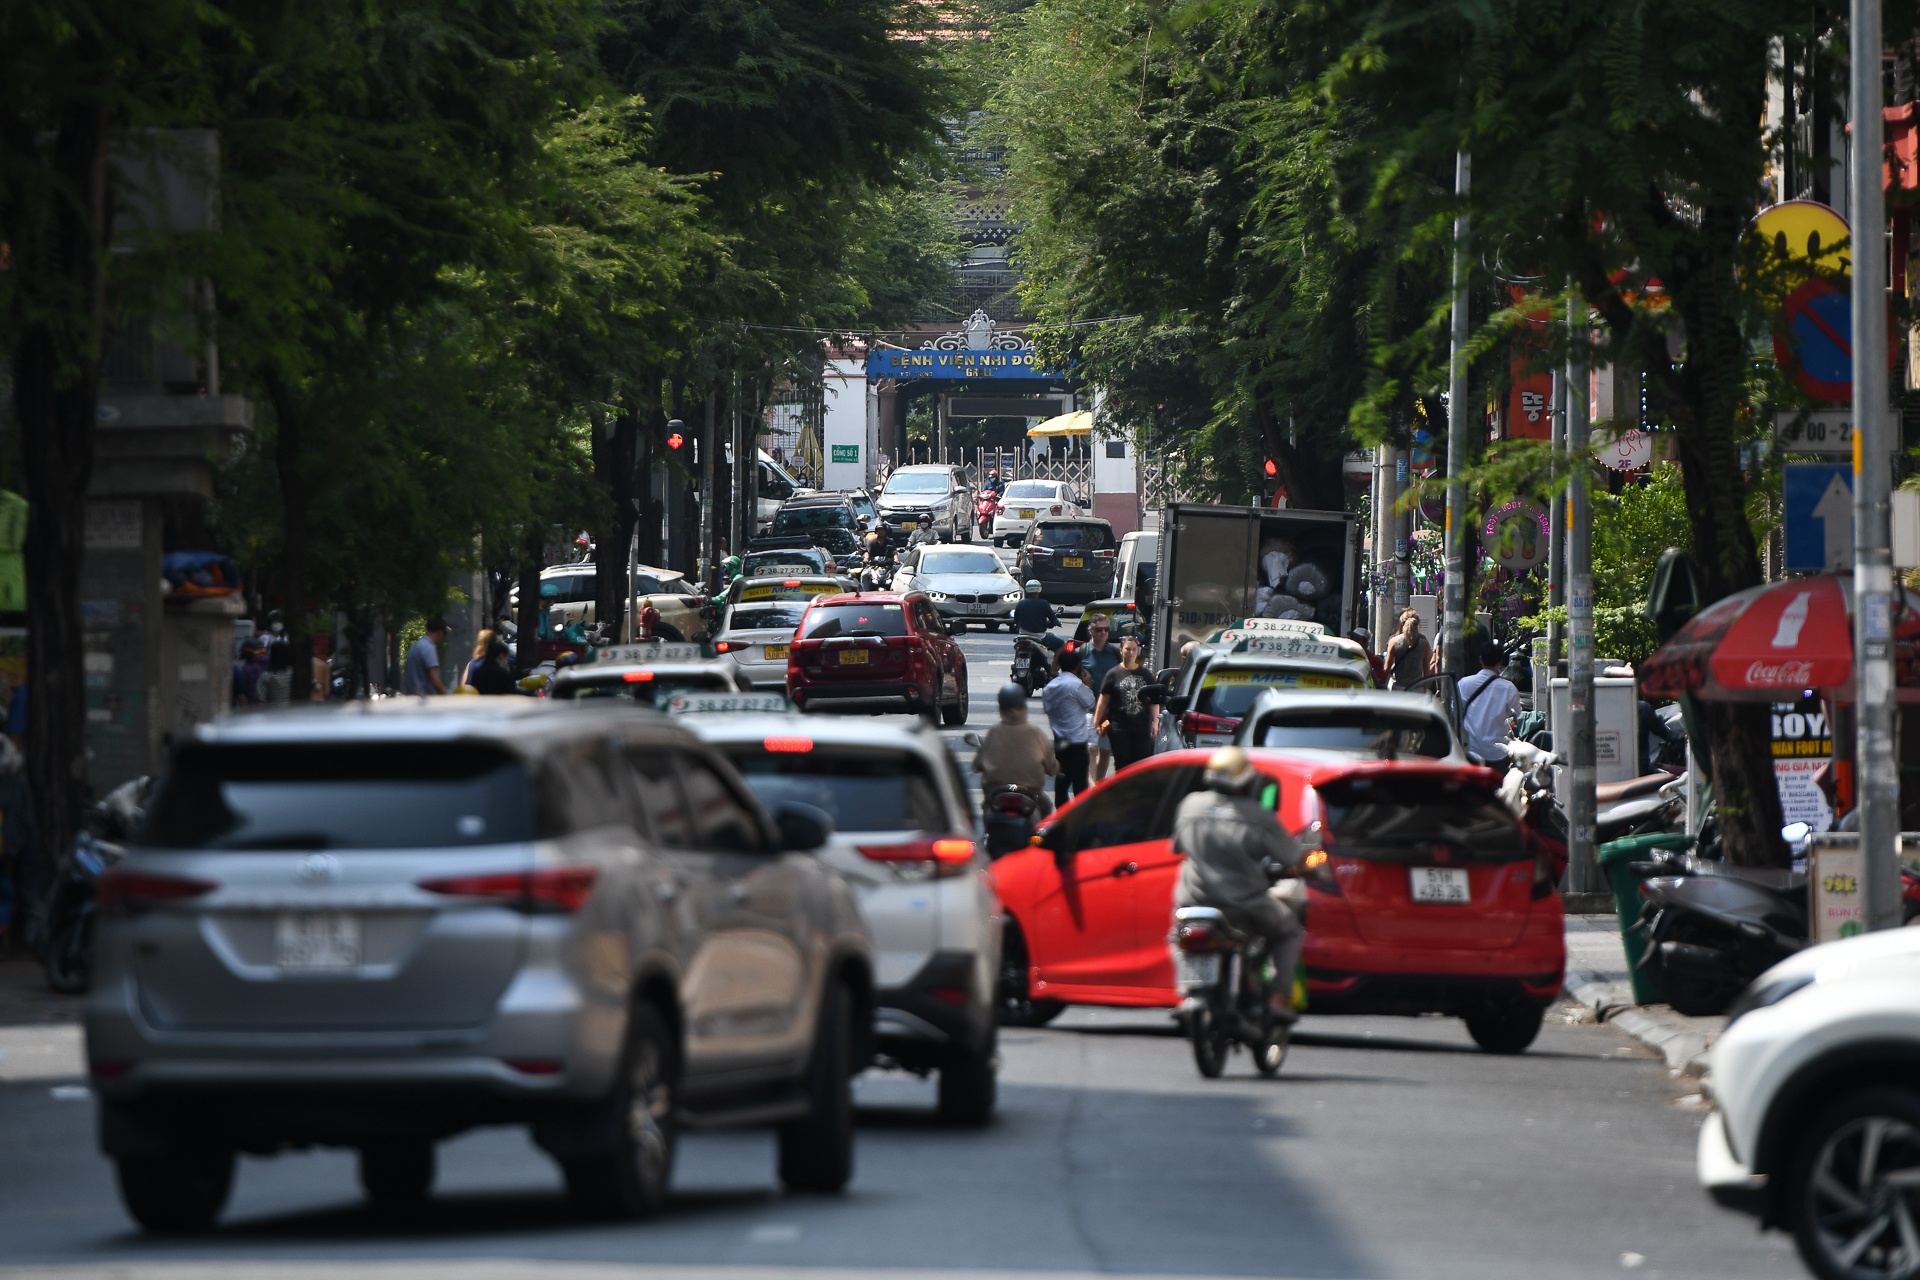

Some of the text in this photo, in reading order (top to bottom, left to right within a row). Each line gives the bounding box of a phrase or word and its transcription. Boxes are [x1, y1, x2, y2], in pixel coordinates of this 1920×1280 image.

[938, 353, 975, 369] VIỆN
[979, 355, 1007, 366] NHI
[1618, 460, 1631, 468] 2F
[771, 586, 802, 594] MPE
[1268, 642, 1336, 655] 38.27 27 27
[1251, 673, 1300, 684] MPE
[1796, 741, 1820, 754] FOOT
